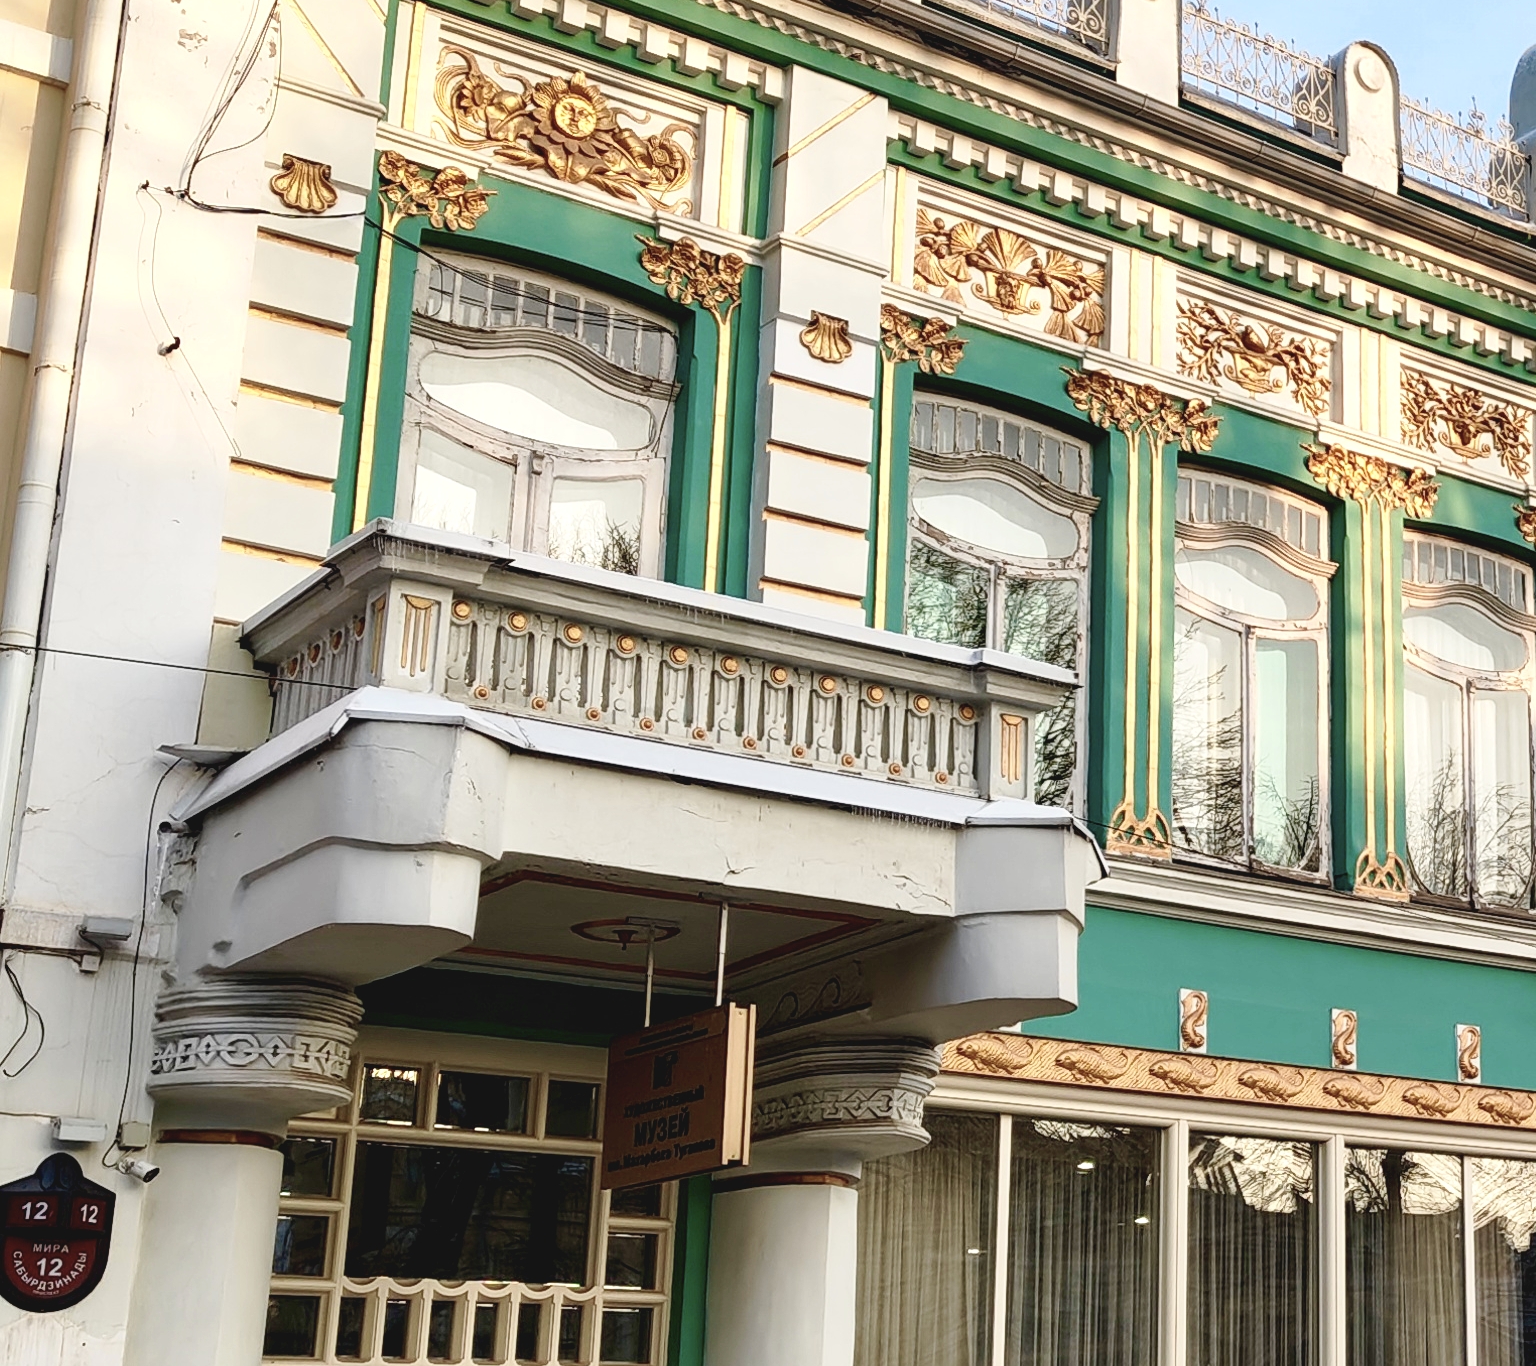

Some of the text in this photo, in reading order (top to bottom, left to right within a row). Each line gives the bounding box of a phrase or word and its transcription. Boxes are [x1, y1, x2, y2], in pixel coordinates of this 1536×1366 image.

[634, 1107, 690, 1147] МУЗЕЙ
[22, 1202, 49, 1220] 12
[80, 1204, 99, 1223] 12
[33, 1243, 69, 1253] МИРА
[13, 1250, 87, 1291] САБЫРДЗИНАДЫ
[36, 1257, 63, 1277] 12
